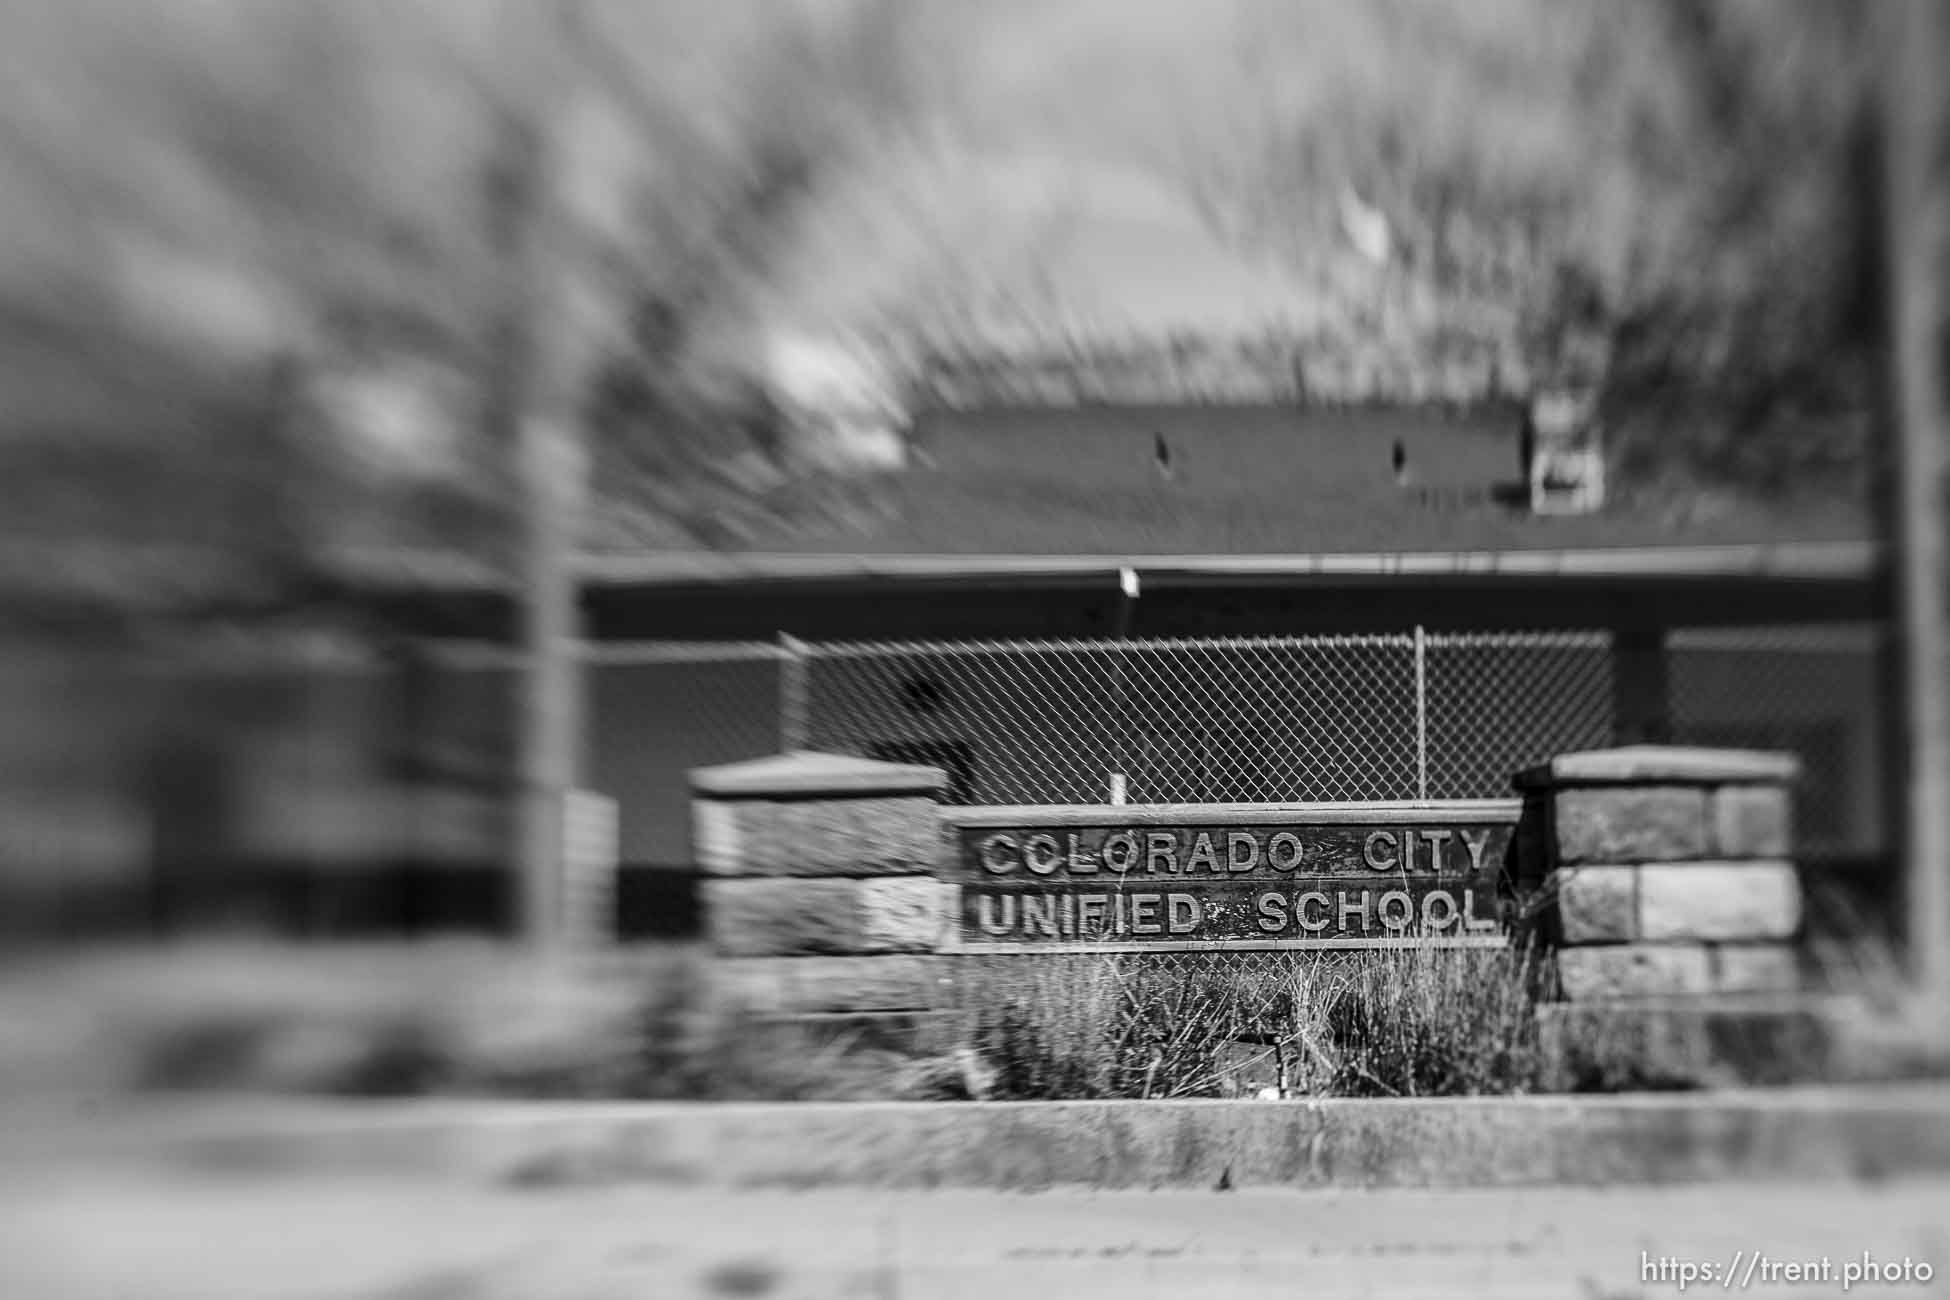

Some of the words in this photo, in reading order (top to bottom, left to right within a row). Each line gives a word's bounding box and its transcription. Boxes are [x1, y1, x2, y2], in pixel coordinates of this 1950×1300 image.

[981, 832, 1304, 875] COLORADO
[1363, 830, 1491, 871] CITY
[979, 893, 1202, 936] UNIFIED
[1257, 889, 1497, 932] SCHOOL
